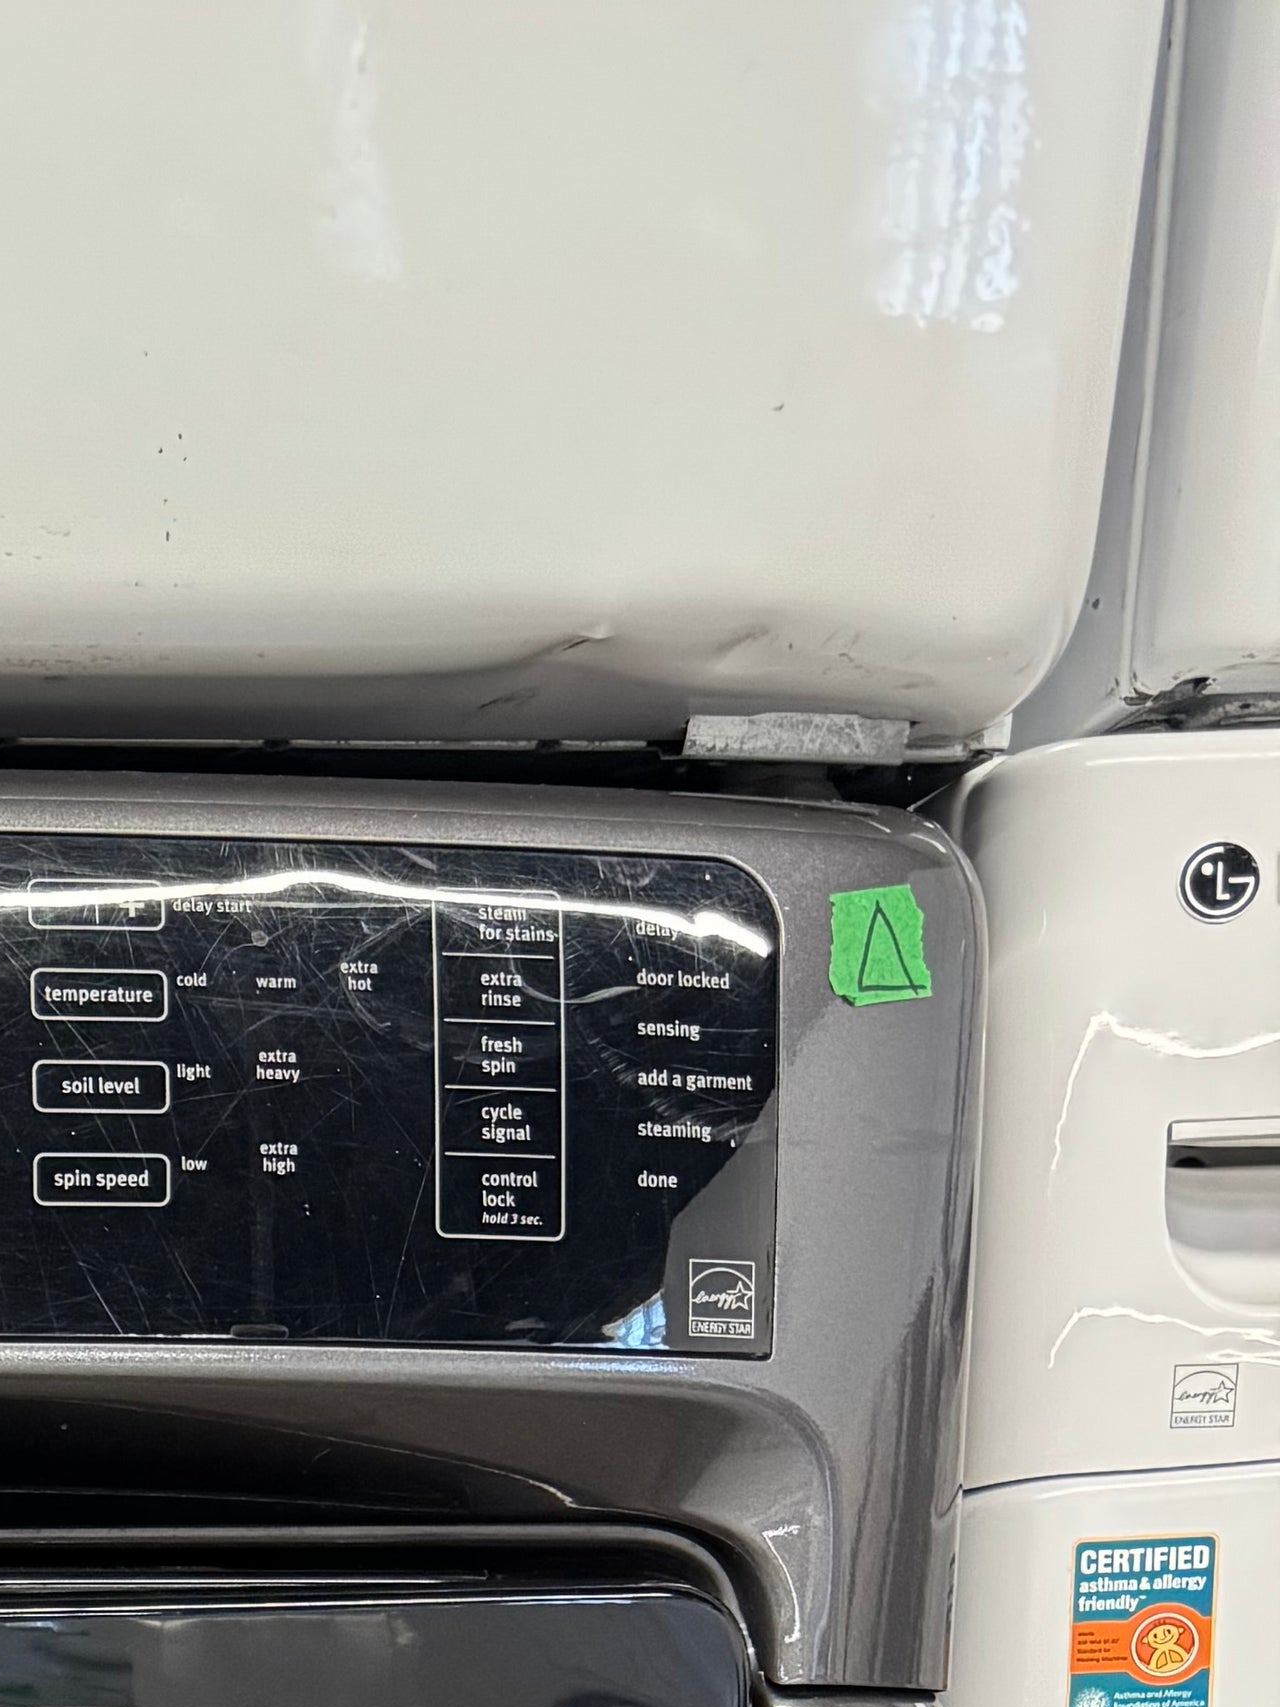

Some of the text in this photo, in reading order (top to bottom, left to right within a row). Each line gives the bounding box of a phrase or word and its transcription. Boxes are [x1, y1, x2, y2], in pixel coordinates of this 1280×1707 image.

[172, 898, 251, 915] delay start
[478, 906, 527, 921] steam
[479, 924, 555, 943] for stains
[340, 961, 377, 977] extra
[481, 969, 525, 986] extra
[177, 973, 206, 986] cold
[256, 978, 296, 988] warm
[348, 976, 371, 990] hot
[637, 968, 729, 989] door locked
[45, 987, 152, 1005] temperature
[482, 990, 521, 1006] rinse
[638, 1020, 700, 1041] sensing
[482, 1036, 522, 1052] fresh
[259, 1050, 296, 1066] extra
[482, 1057, 515, 1075] spin
[177, 1064, 210, 1081] light
[257, 1065, 299, 1083] heavy
[638, 1069, 752, 1091] add a garment
[63, 1077, 139, 1094] soil level
[482, 1104, 522, 1125] cycle
[482, 1122, 530, 1143] signal
[638, 1121, 711, 1142] steaming
[260, 1143, 297, 1155] extra
[182, 1156, 207, 1170] low
[263, 1158, 295, 1175] high
[55, 1170, 148, 1190] spin speed
[482, 1172, 537, 1187] control
[638, 1171, 677, 1188] done
[483, 1190, 515, 1206] lock
[482, 1211, 543, 1226] hold 3 sec.
[692, 1321, 752, 1335] ENERGY STAR
[1209, 1415, 1230, 1424] STAR
[1080, 1545, 1210, 1575] CERTIFIED
[1079, 1573, 1207, 1593] asthma & allergy
